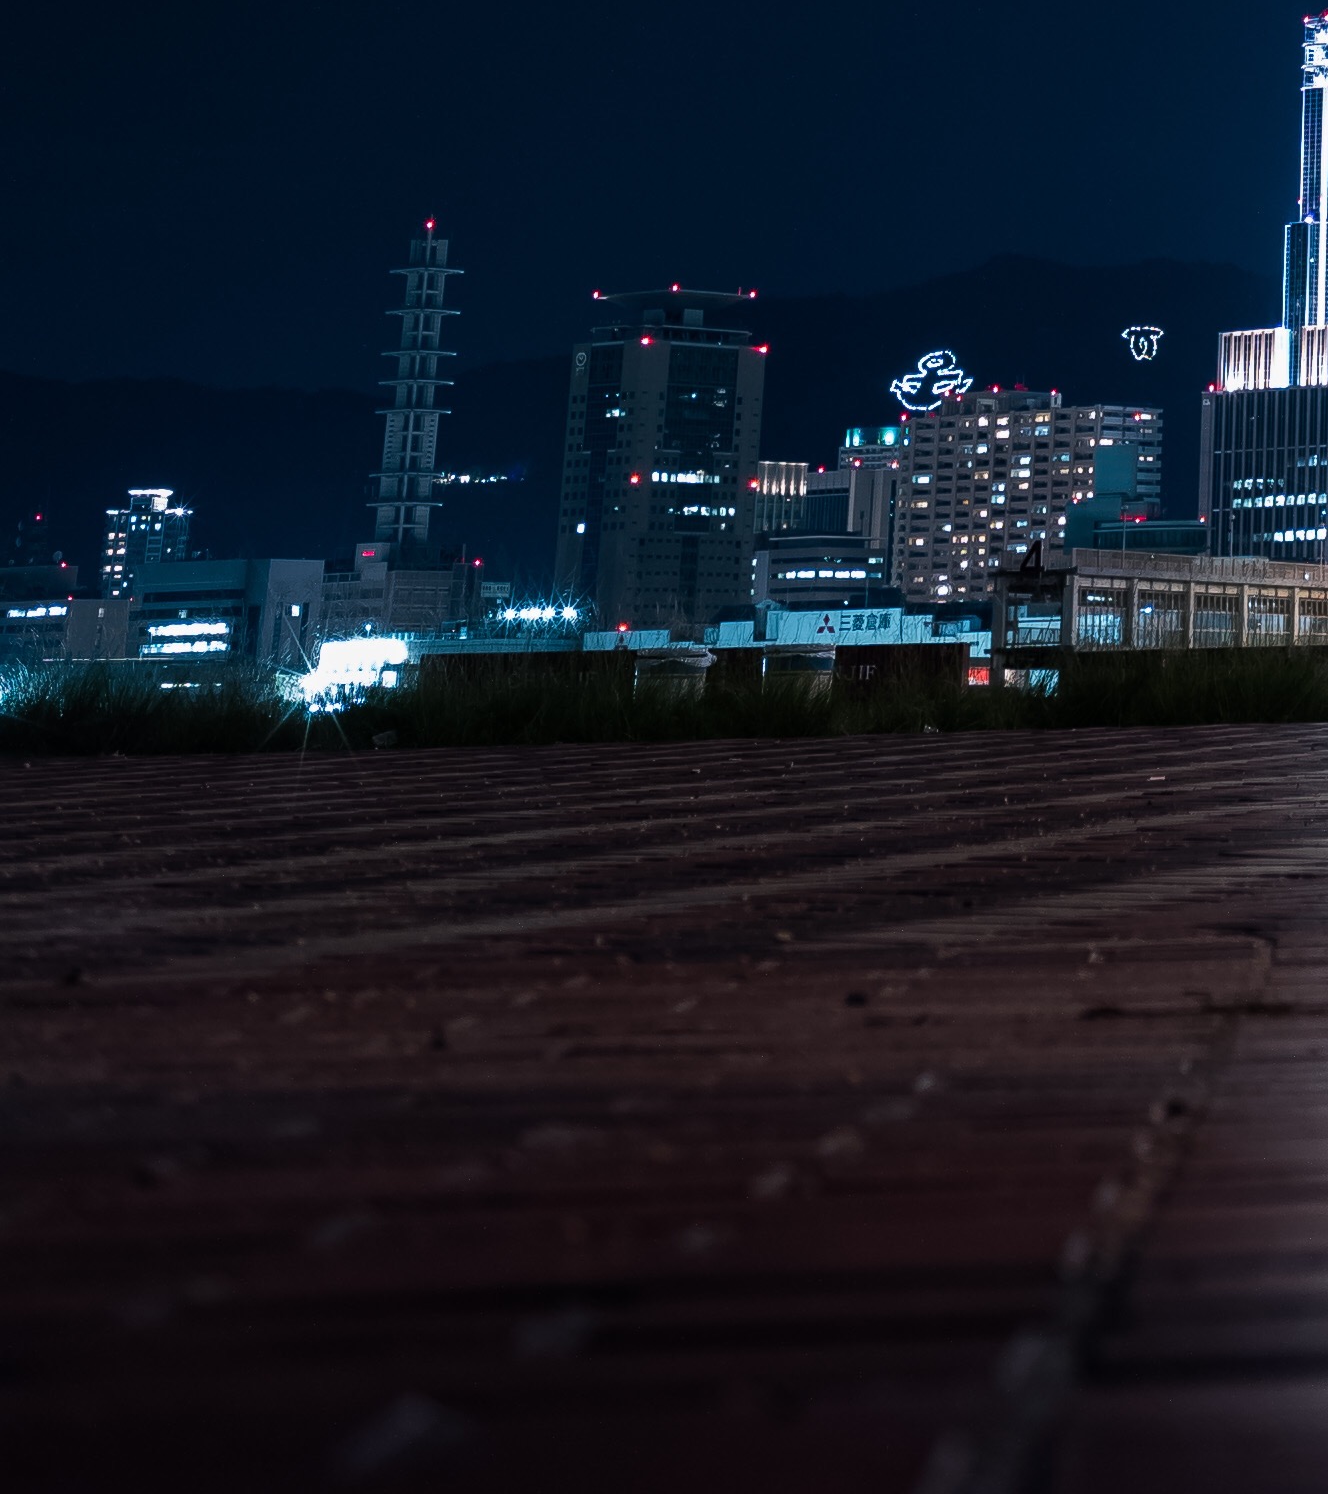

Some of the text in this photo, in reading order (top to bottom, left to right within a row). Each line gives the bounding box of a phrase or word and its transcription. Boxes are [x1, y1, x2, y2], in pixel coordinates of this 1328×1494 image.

[1020, 540, 1045, 575] 4
[838, 612, 892, 632] 三菱倉庫
